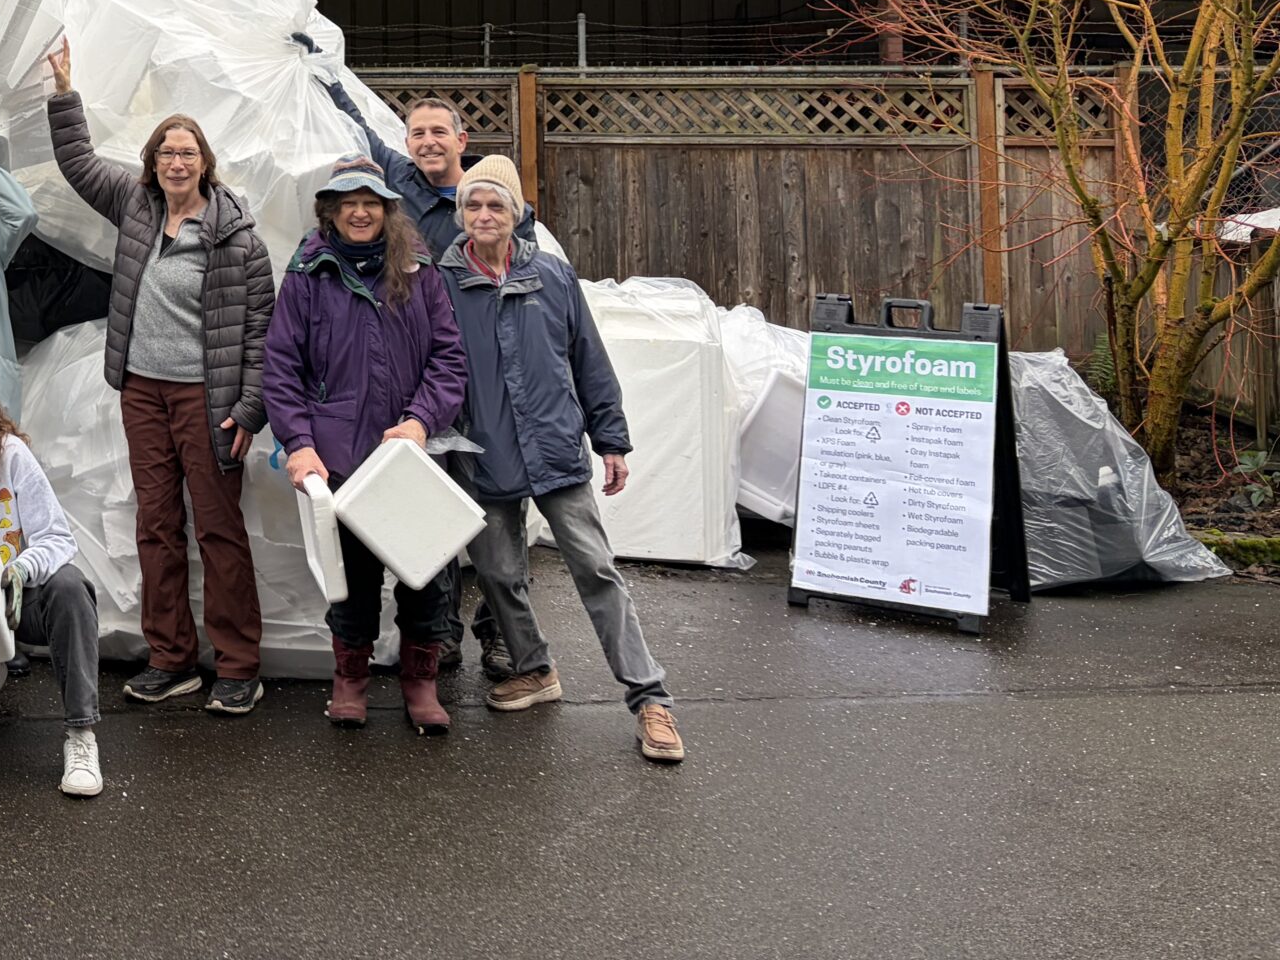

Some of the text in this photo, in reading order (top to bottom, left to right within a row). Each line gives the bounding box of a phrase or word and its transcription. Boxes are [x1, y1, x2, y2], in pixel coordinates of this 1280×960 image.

[826, 346, 976, 378] Styrofoam
[820, 376, 840, 384] Must
[852, 379, 874, 388] clean
[875, 380, 890, 388] and
[891, 381, 907, 390] free
[908, 382, 920, 390] of
[920, 384, 938, 393] tape
[940, 385, 955, 394] and
[836, 400, 880, 412] ACCEPTED
[822, 414, 842, 422] Clean
[915, 407, 982, 420] NOT ACCEPTED
[912, 422, 962, 434] Spray-in foam
[910, 435, 964, 446] Instapak foam
[820, 450, 854, 458] insulation
[910, 448, 960, 460] Gray Instapak
[910, 460, 929, 468] foam
[820, 470, 886, 484] Takeout containers
[956, 478, 976, 486] foam
[817, 504, 874, 518] Shipping coolers
[908, 498, 966, 512] Dirty Styrofoam
[817, 516, 880, 530] Styrofoam sheets
[908, 512, 964, 524] Wet Styrofoam
[816, 528, 882, 542] Separately bagged
[907, 524, 958, 538] Biodegradable
[815, 540, 872, 552] packing peanuts
[906, 539, 967, 552] packing peanuts
[814, 550, 838, 560] Bubble
[846, 555, 870, 564] plastic
[817, 571, 858, 581] Snohomish
[860, 577, 887, 588] County
